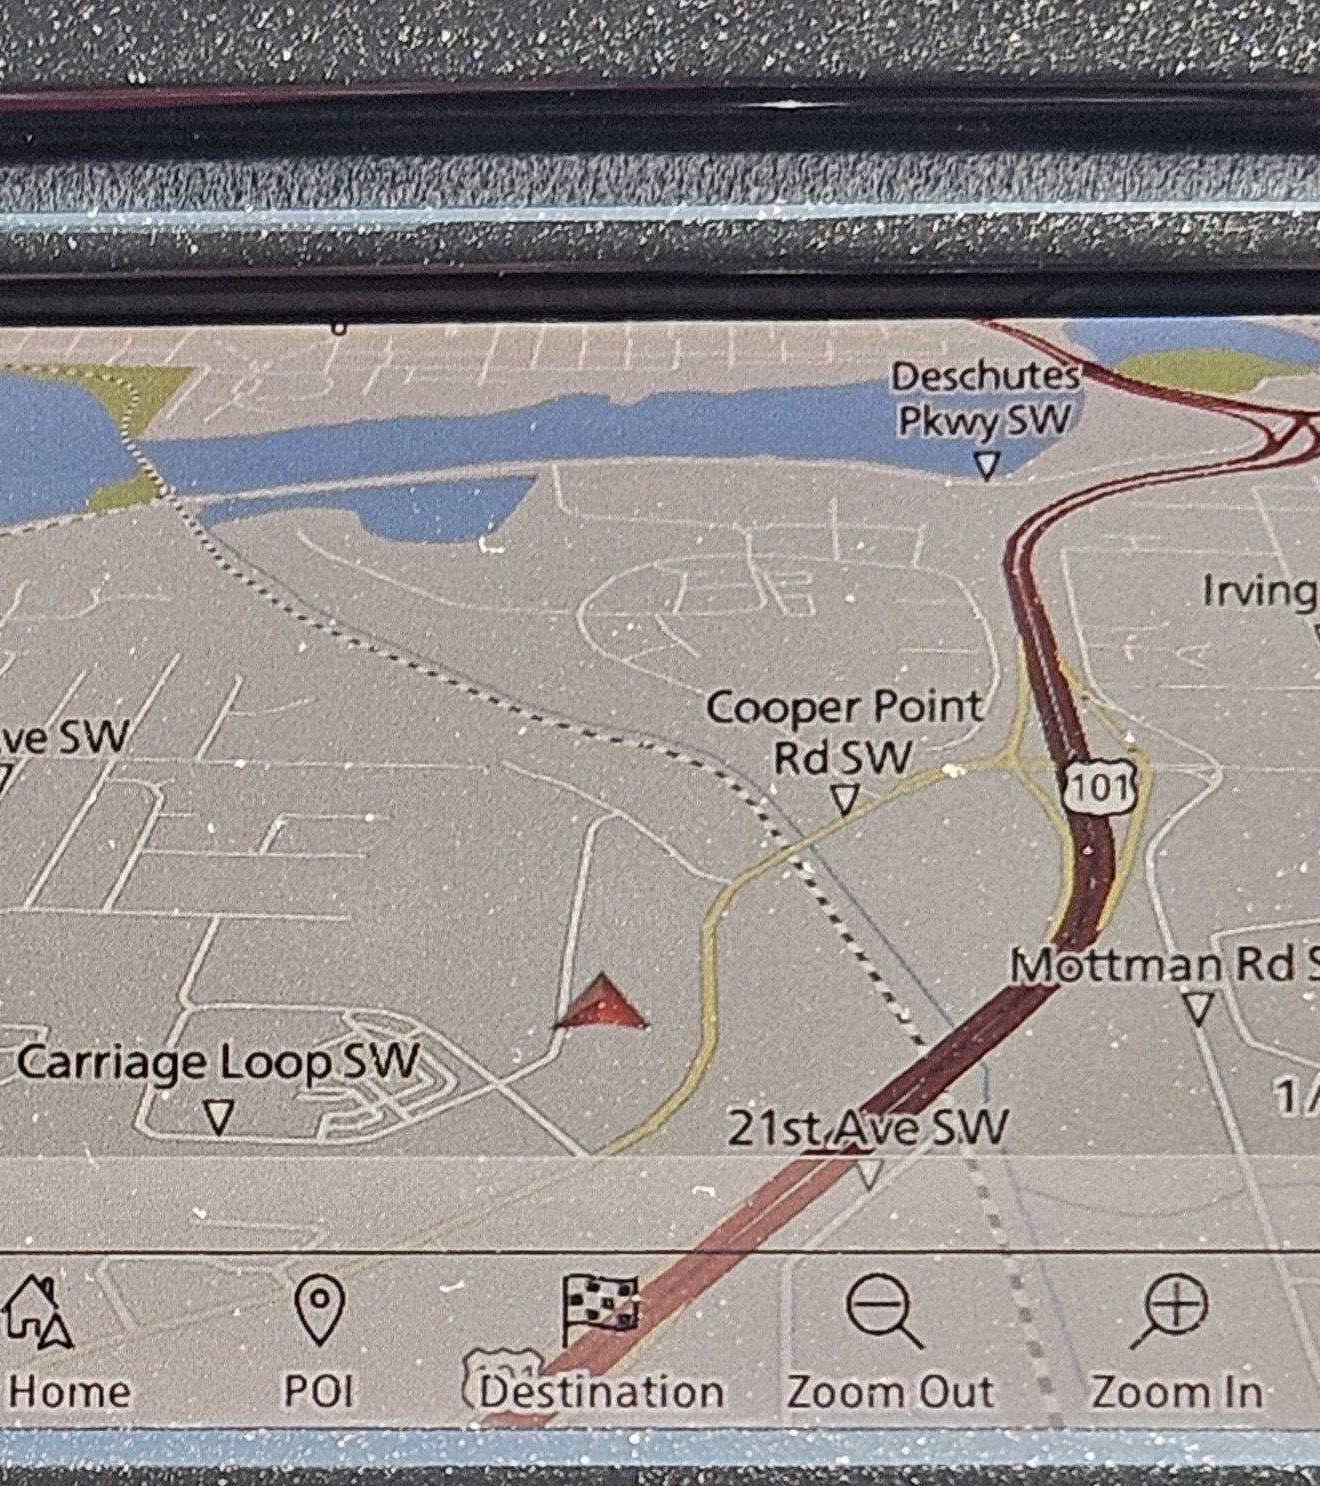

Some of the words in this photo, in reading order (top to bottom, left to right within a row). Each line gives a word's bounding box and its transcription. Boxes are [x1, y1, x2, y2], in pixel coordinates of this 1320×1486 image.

[892, 359, 1080, 391] Deschutes
[899, 405, 1003, 442] Pkwy
[1007, 405, 1073, 435] SW
[1204, 572, 1316, 614] Irving
[706, 690, 861, 731] Cooper
[876, 689, 982, 723] Point
[60, 719, 131, 755] SW
[776, 741, 834, 775] Rd
[840, 741, 914, 775] SW
[1071, 774, 1126, 801] 101
[1010, 946, 1222, 982] Mottman
[1238, 946, 1295, 982] Rd
[16, 1044, 207, 1089] Carriage
[222, 1044, 332, 1089] Loop
[345, 1044, 420, 1079] SW
[729, 1109, 818, 1147] 21st
[833, 1109, 918, 1147] Ave
[933, 1109, 1010, 1147] SW
[10, 1374, 131, 1408] Home
[284, 1374, 354, 1408] POI
[481, 1374, 725, 1409] Destination
[787, 1374, 905, 1409] Zoom
[920, 1374, 995, 1409] Out
[1091, 1374, 1211, 1409] Zoom
[1226, 1374, 1263, 1409] In
